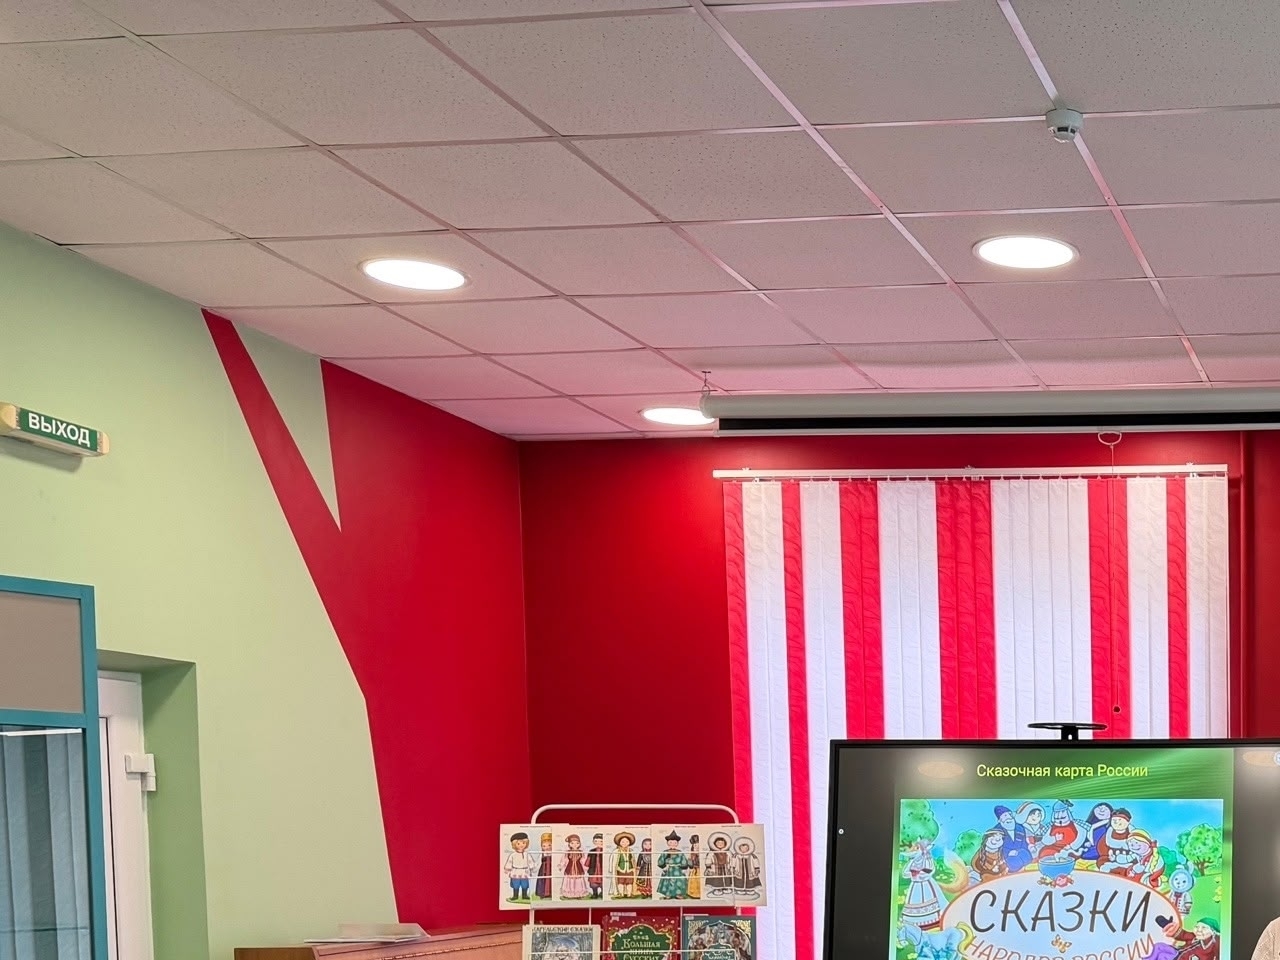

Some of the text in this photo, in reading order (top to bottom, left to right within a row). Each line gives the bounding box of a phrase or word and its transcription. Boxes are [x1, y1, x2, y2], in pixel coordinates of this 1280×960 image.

[28, 412, 91, 448] ВЫХОД
[976, 763, 1148, 780] Сказочная карта России
[969, 889, 1152, 934] СКАЗКИ
[623, 938, 661, 949] БОЛЬШАЯ
